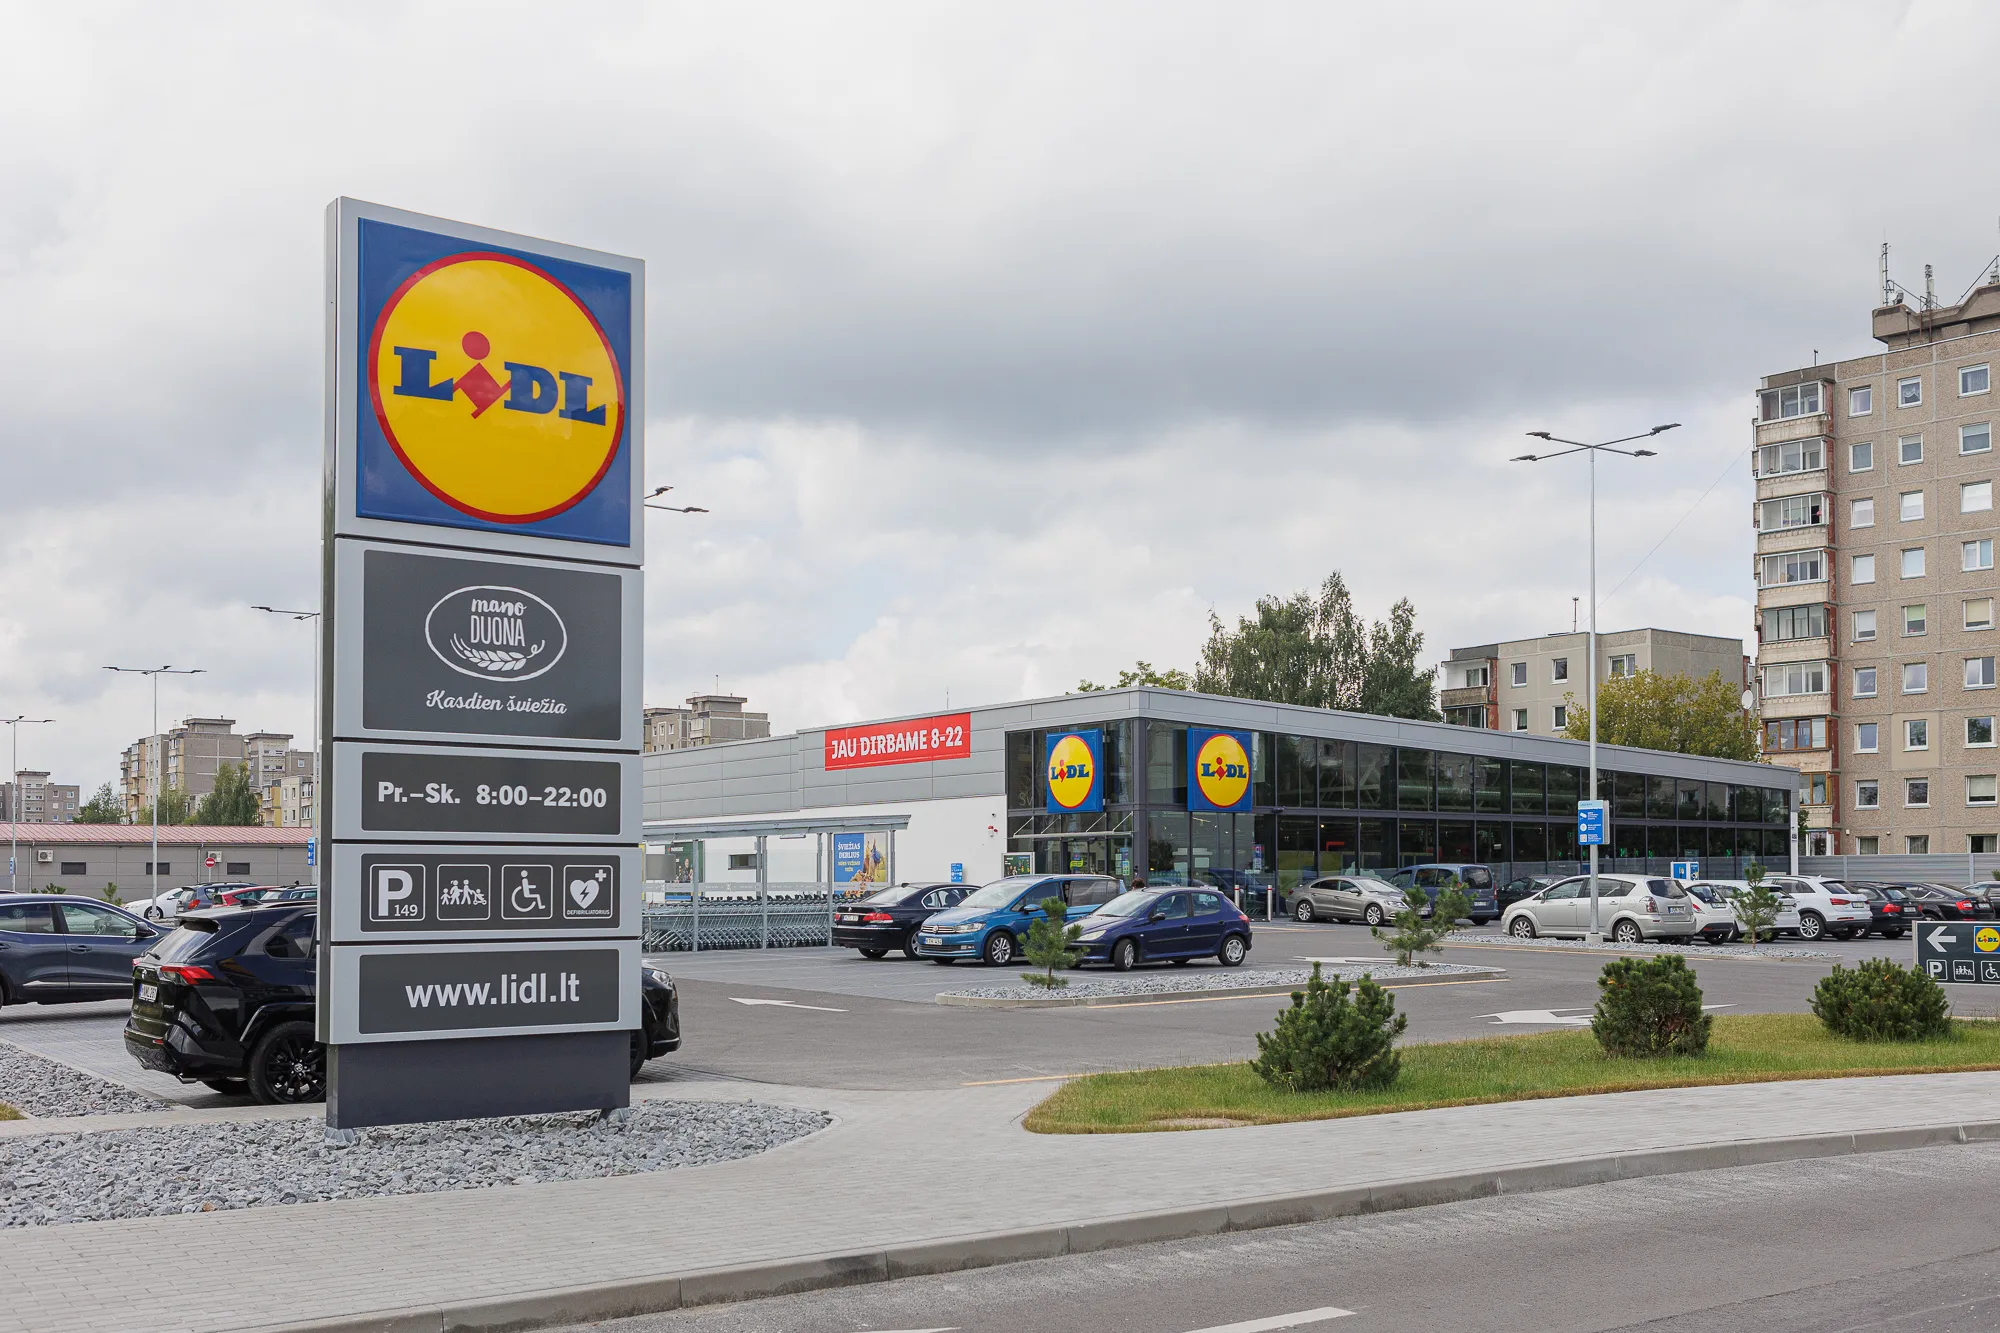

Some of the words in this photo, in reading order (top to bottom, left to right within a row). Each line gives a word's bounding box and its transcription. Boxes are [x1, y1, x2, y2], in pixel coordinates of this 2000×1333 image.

[471, 598, 527, 616] mano
[470, 615, 525, 647] DUONA
[426, 689, 503, 711] Kasdien
[506, 695, 567, 715] šviežia
[831, 737, 857, 760] JAU
[860, 729, 927, 756] DIRBAME
[930, 725, 963, 749] 8-22
[394, 904, 418, 917] 149
[405, 972, 580, 1008] www.lidl.lt
